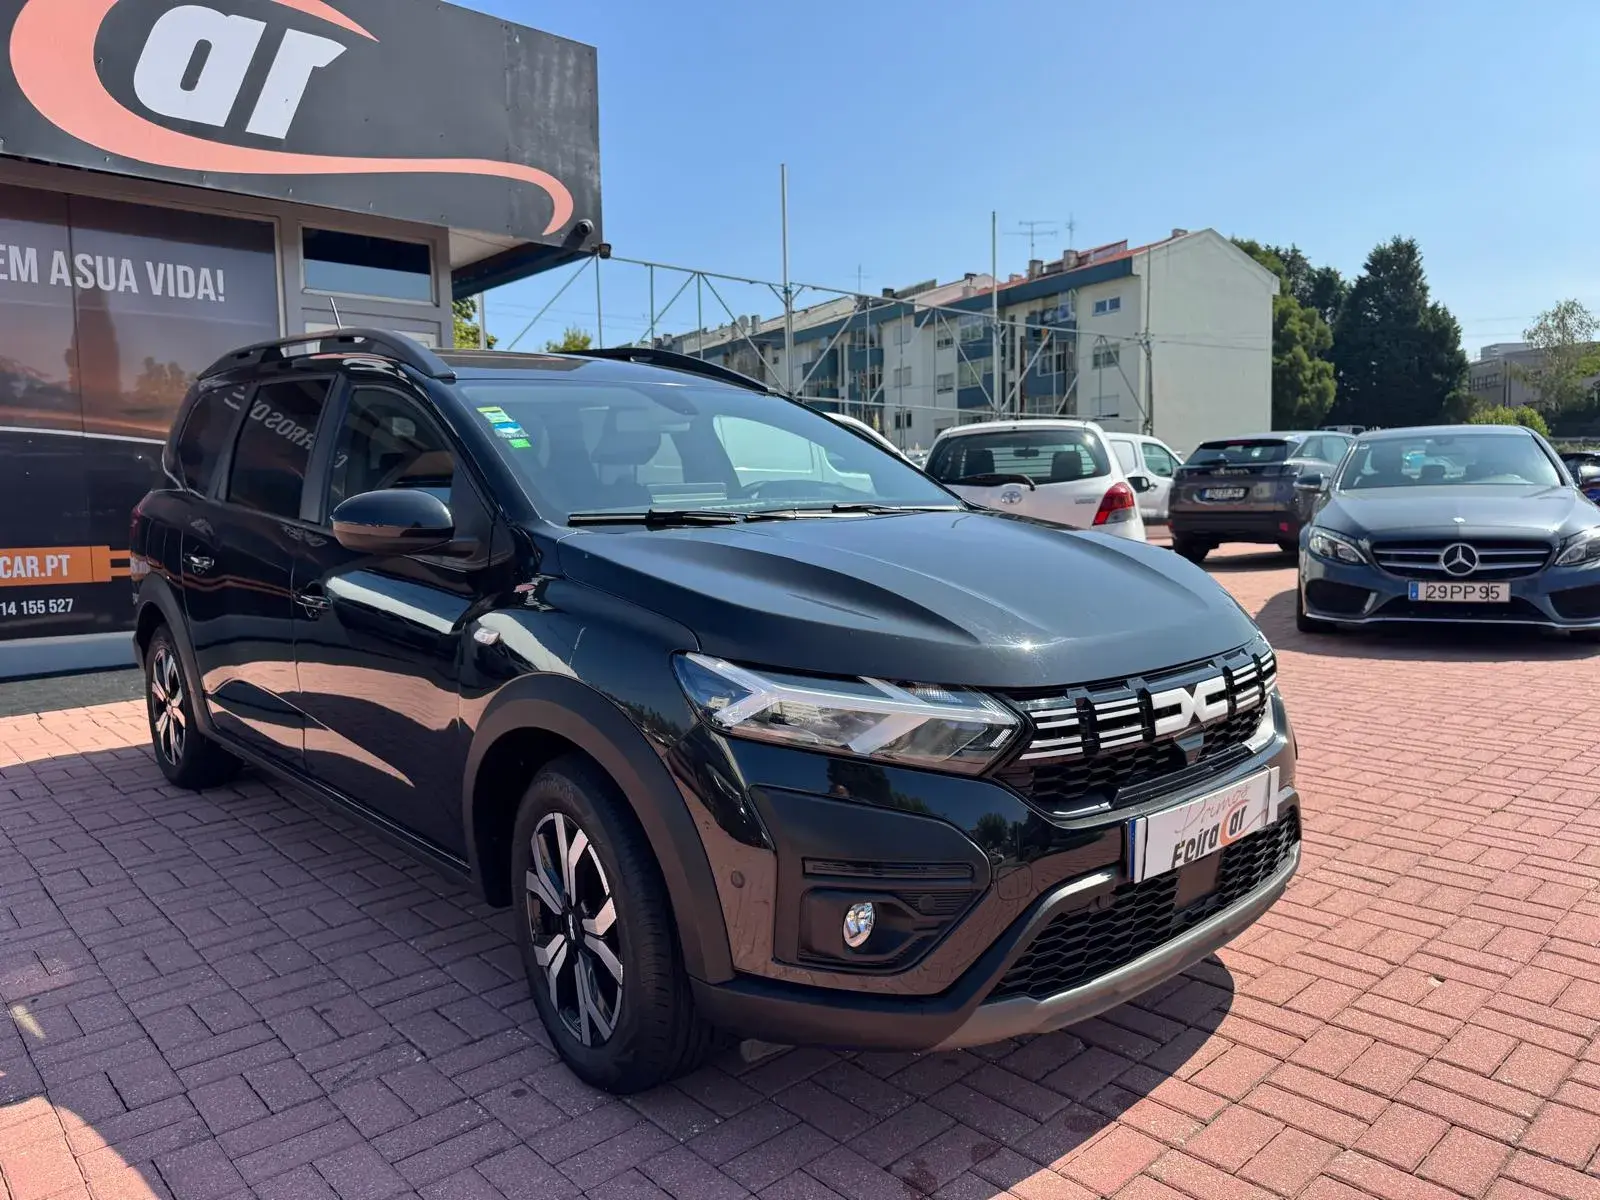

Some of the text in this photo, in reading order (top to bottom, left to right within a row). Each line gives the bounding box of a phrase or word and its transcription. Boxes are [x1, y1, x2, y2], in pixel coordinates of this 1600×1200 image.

[145, 260, 225, 302] VIDA!
[21, 600, 46, 615] 155
[48, 598, 74, 613] 527
